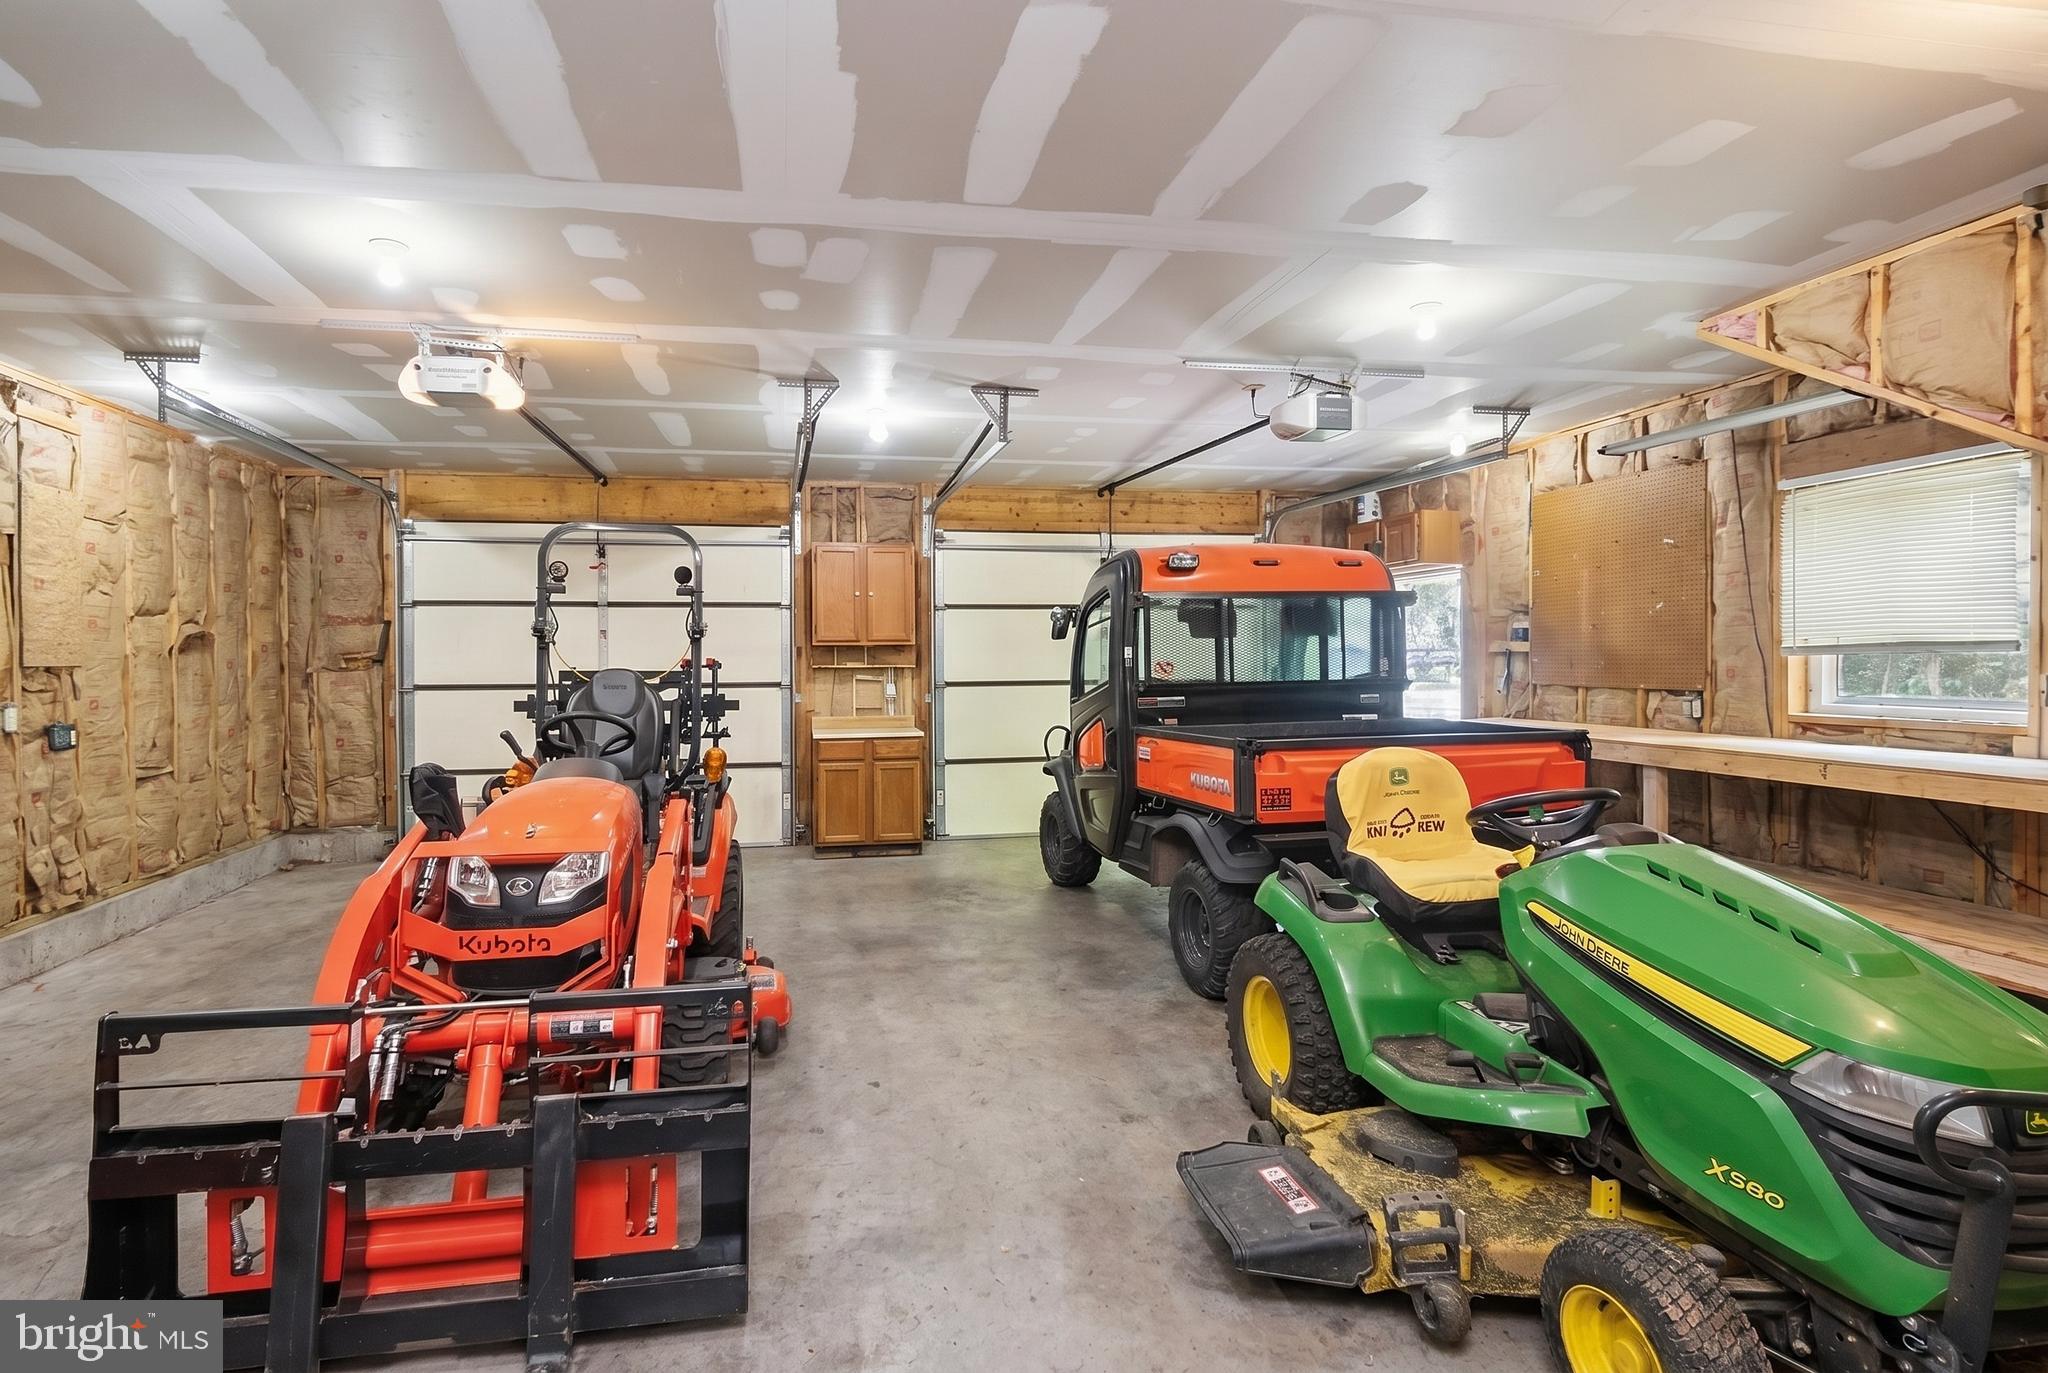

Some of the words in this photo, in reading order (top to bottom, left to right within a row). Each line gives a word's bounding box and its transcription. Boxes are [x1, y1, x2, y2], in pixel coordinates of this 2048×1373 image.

[1190, 771, 1231, 794] KUBOTA
[1418, 820, 1445, 832] REW
[458, 933, 551, 954] Kubota
[1554, 918, 1585, 947] JOHN
[1586, 938, 1630, 975] DEERE
